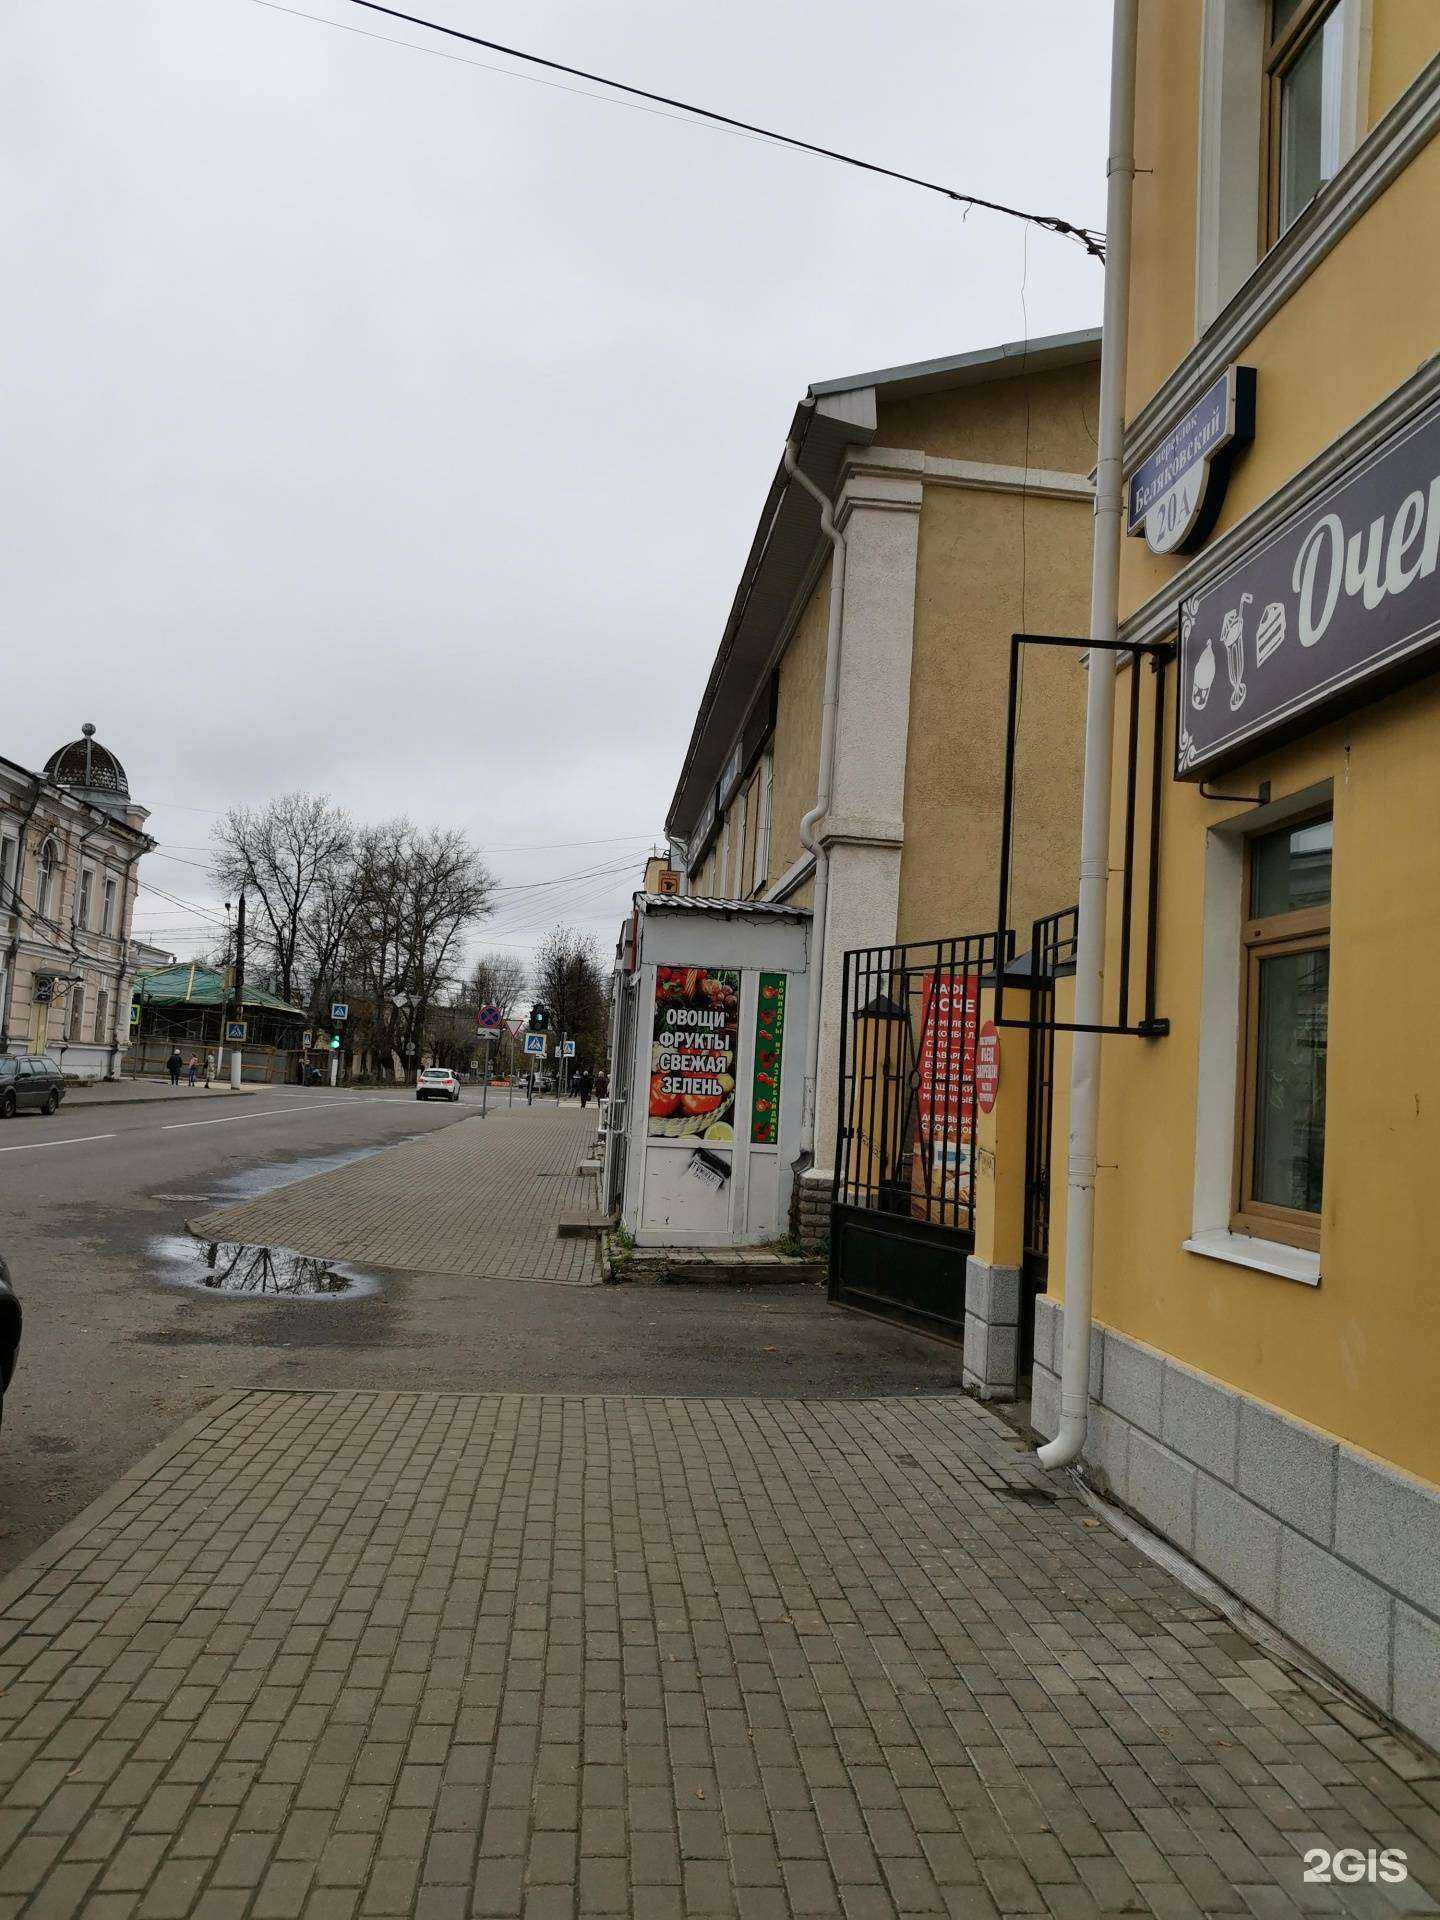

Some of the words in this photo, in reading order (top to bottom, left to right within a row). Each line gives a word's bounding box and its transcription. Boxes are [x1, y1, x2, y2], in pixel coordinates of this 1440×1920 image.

[1135, 405, 1221, 515] Беляковский
[1156, 486, 1191, 545] 20А
[666, 1008, 725, 1031] ОВОЩИ
[659, 1031, 730, 1051] ФРУКТЫ
[659, 1053, 727, 1073] СВЕЖАЯ
[661, 1076, 723, 1095] ЗЕЛЕНЬ
